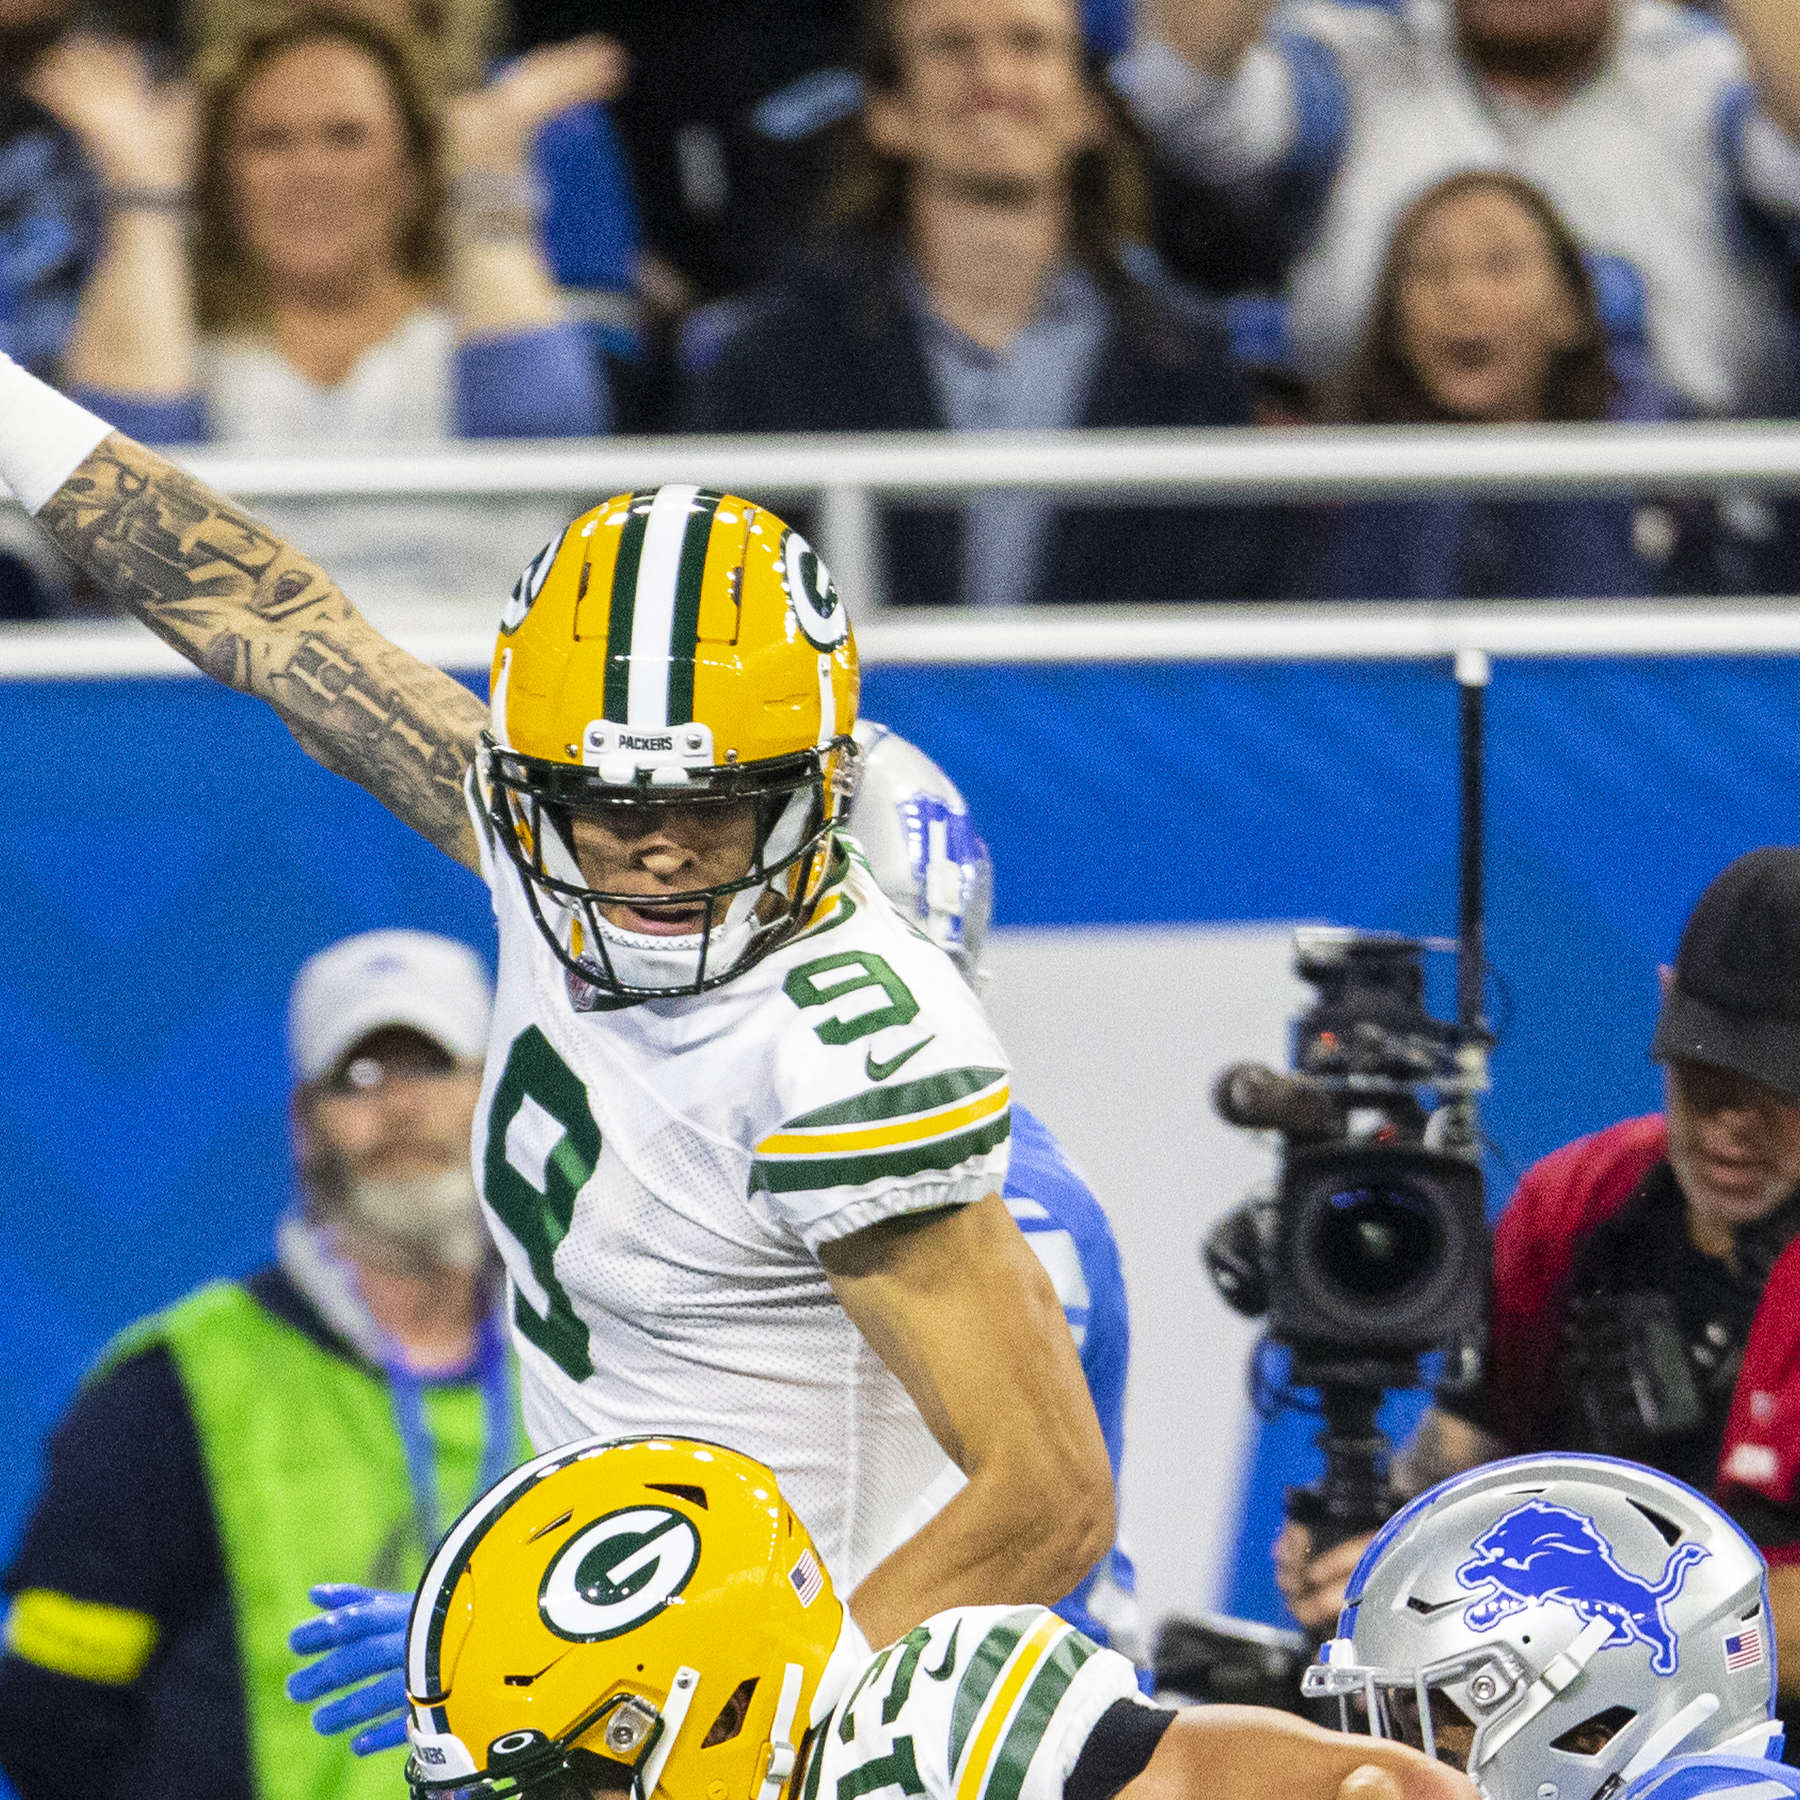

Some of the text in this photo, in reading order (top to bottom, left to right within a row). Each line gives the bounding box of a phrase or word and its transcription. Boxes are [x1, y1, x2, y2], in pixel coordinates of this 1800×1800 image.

[618, 734, 672, 751] PACKERS
[783, 950, 920, 1044] 9
[484, 1024, 602, 1384] 9
